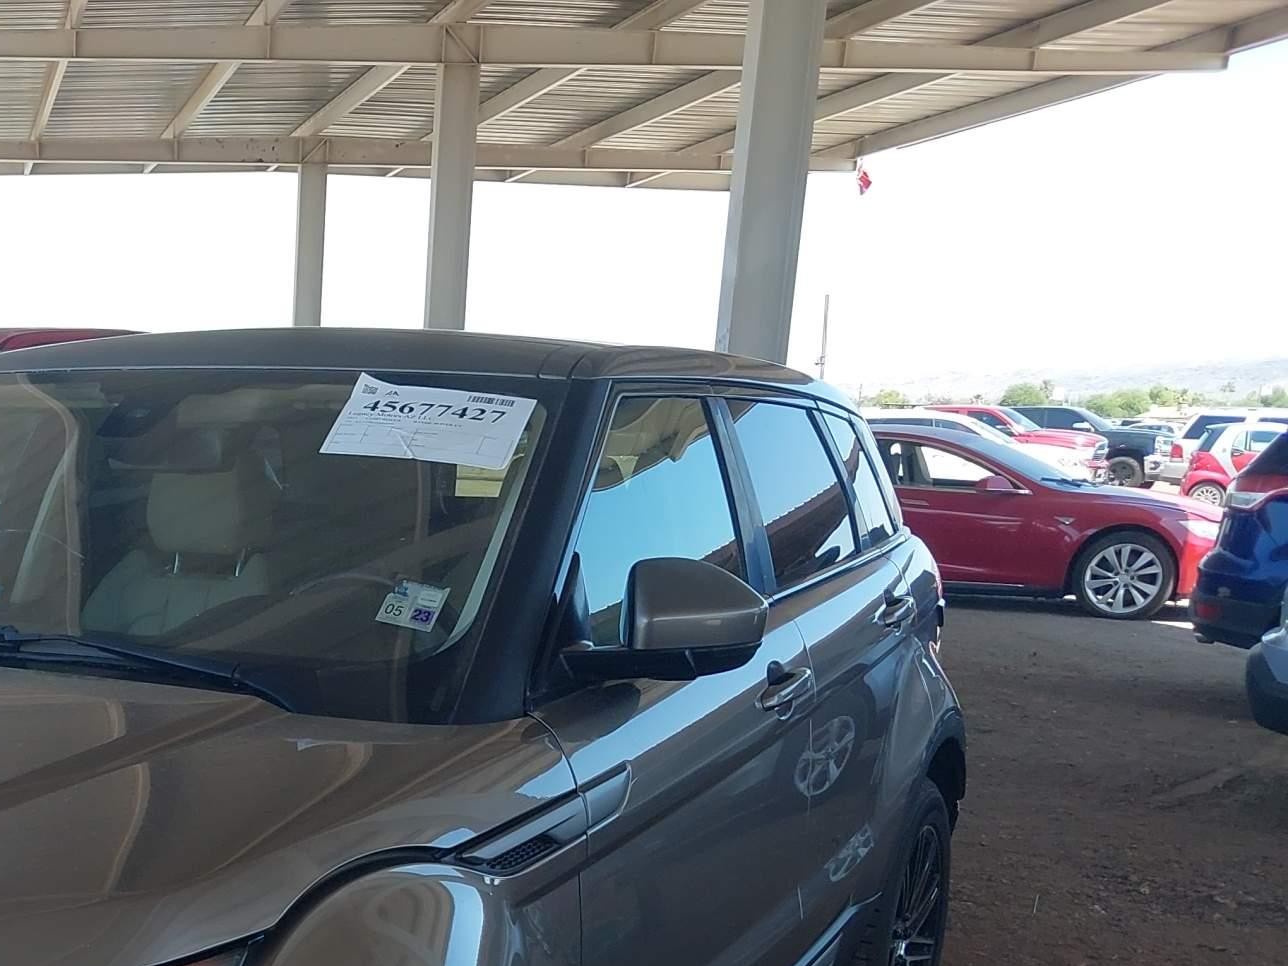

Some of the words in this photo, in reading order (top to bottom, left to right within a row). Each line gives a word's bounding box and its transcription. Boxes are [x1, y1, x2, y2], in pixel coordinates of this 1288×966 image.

[363, 399, 507, 424] 45677427
[384, 603, 404, 617] 05
[411, 608, 432, 622] 23
